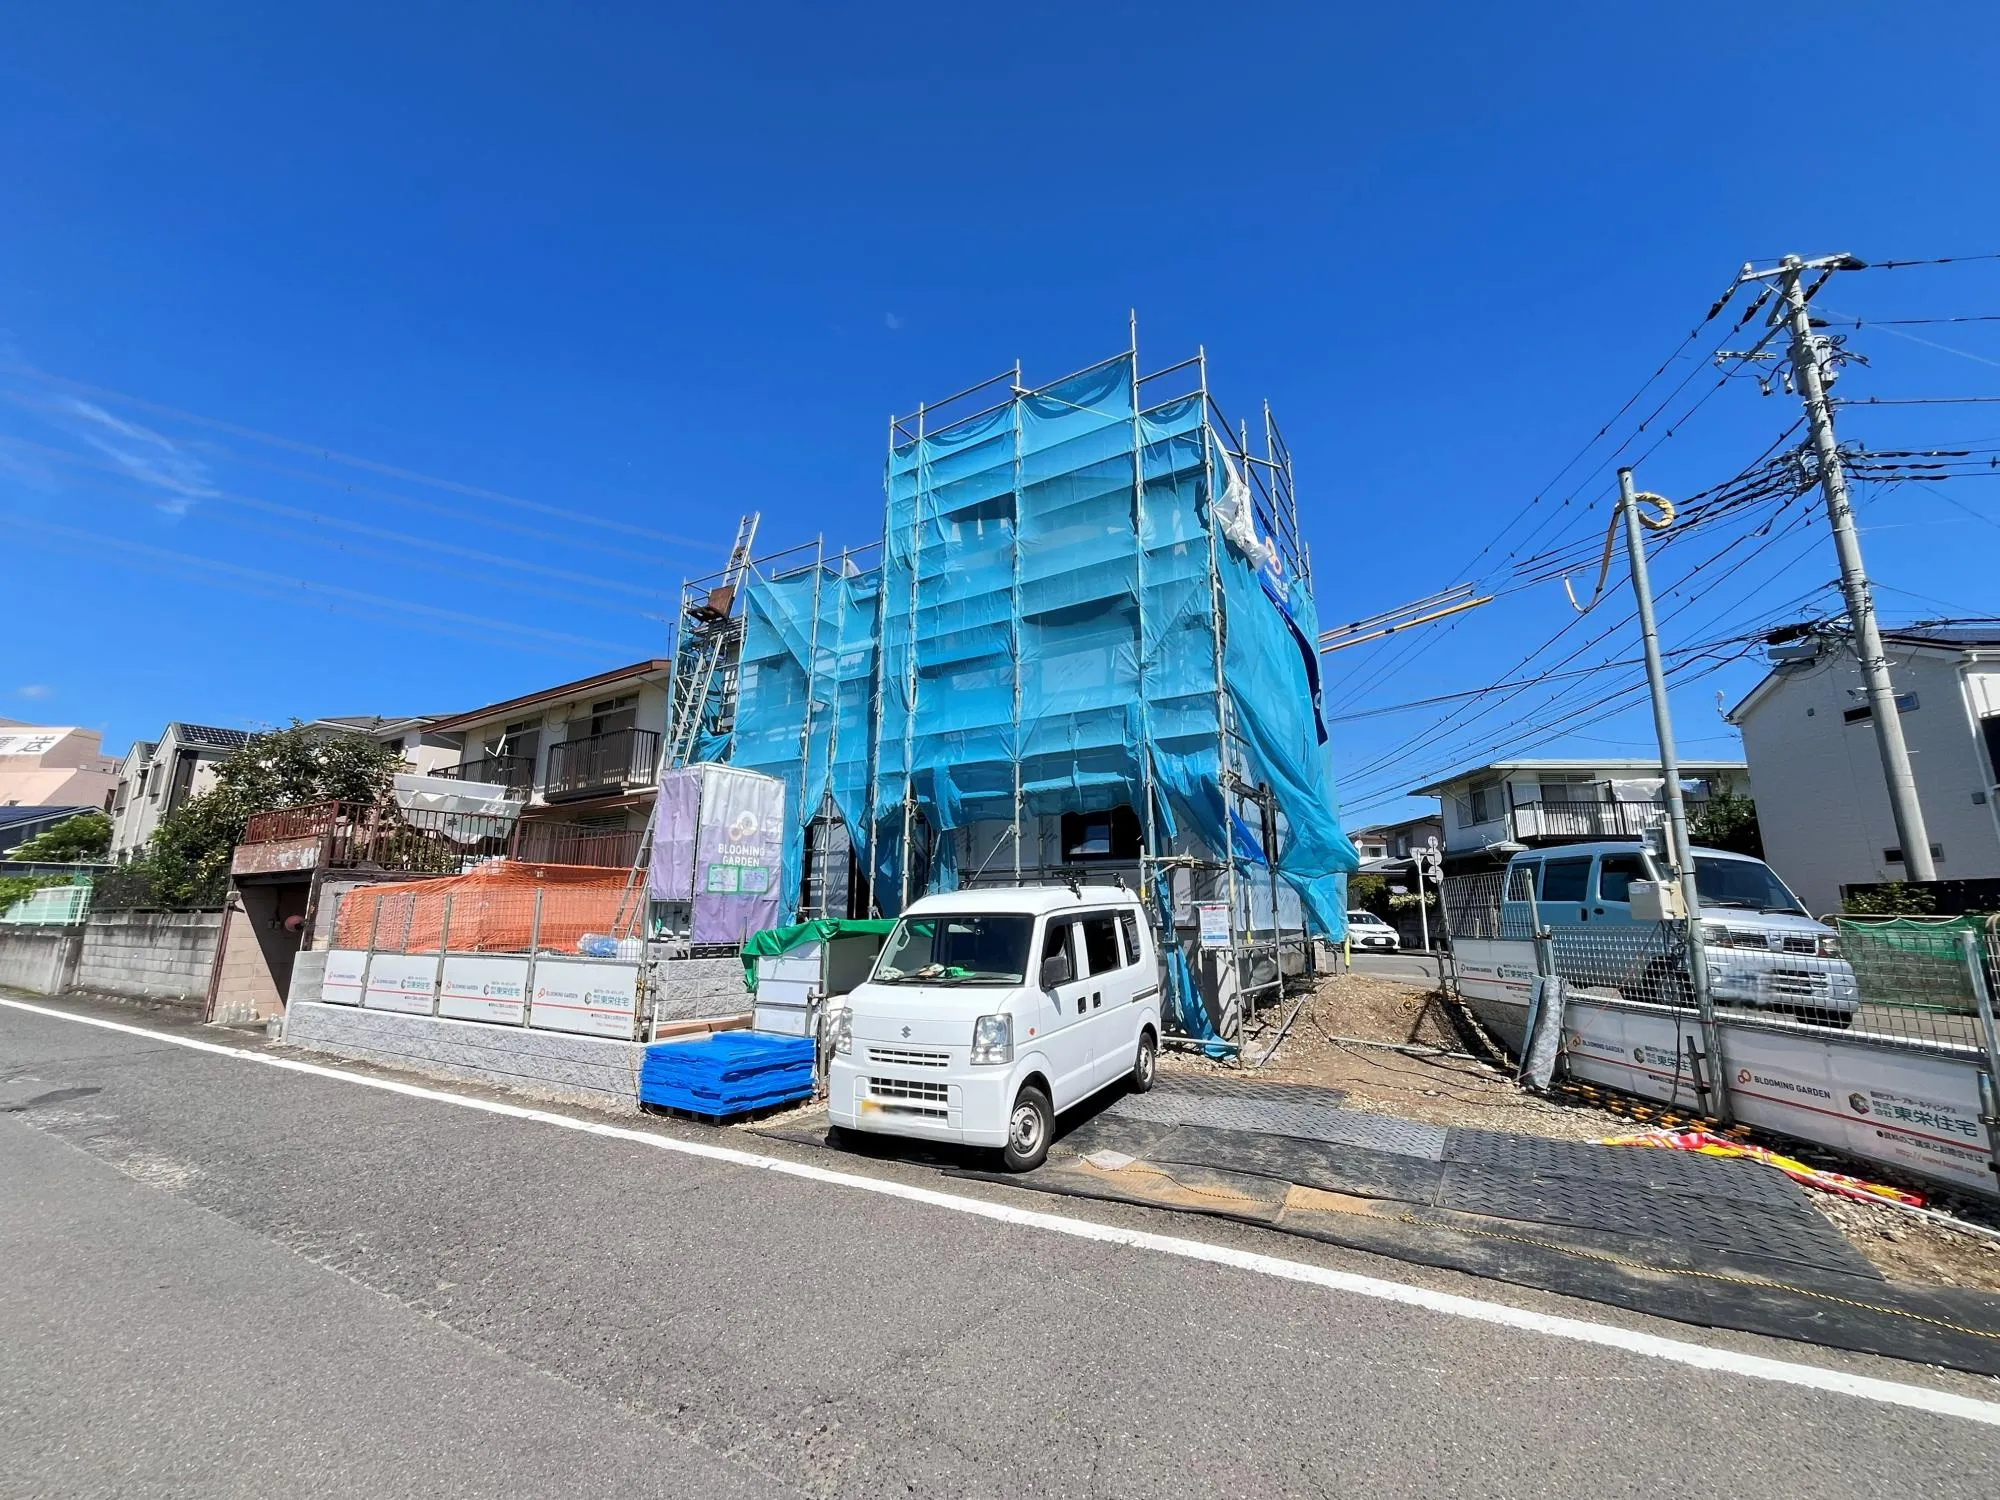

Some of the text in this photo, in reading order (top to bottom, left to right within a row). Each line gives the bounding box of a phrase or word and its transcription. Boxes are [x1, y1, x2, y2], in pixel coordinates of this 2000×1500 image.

[718, 843, 765, 857] BLOOMING
[722, 855, 760, 867] GARDEN
[1754, 1075, 1831, 1099] BLOOMING GARDEN
[1892, 1105, 1978, 1138] 東栄住宅
